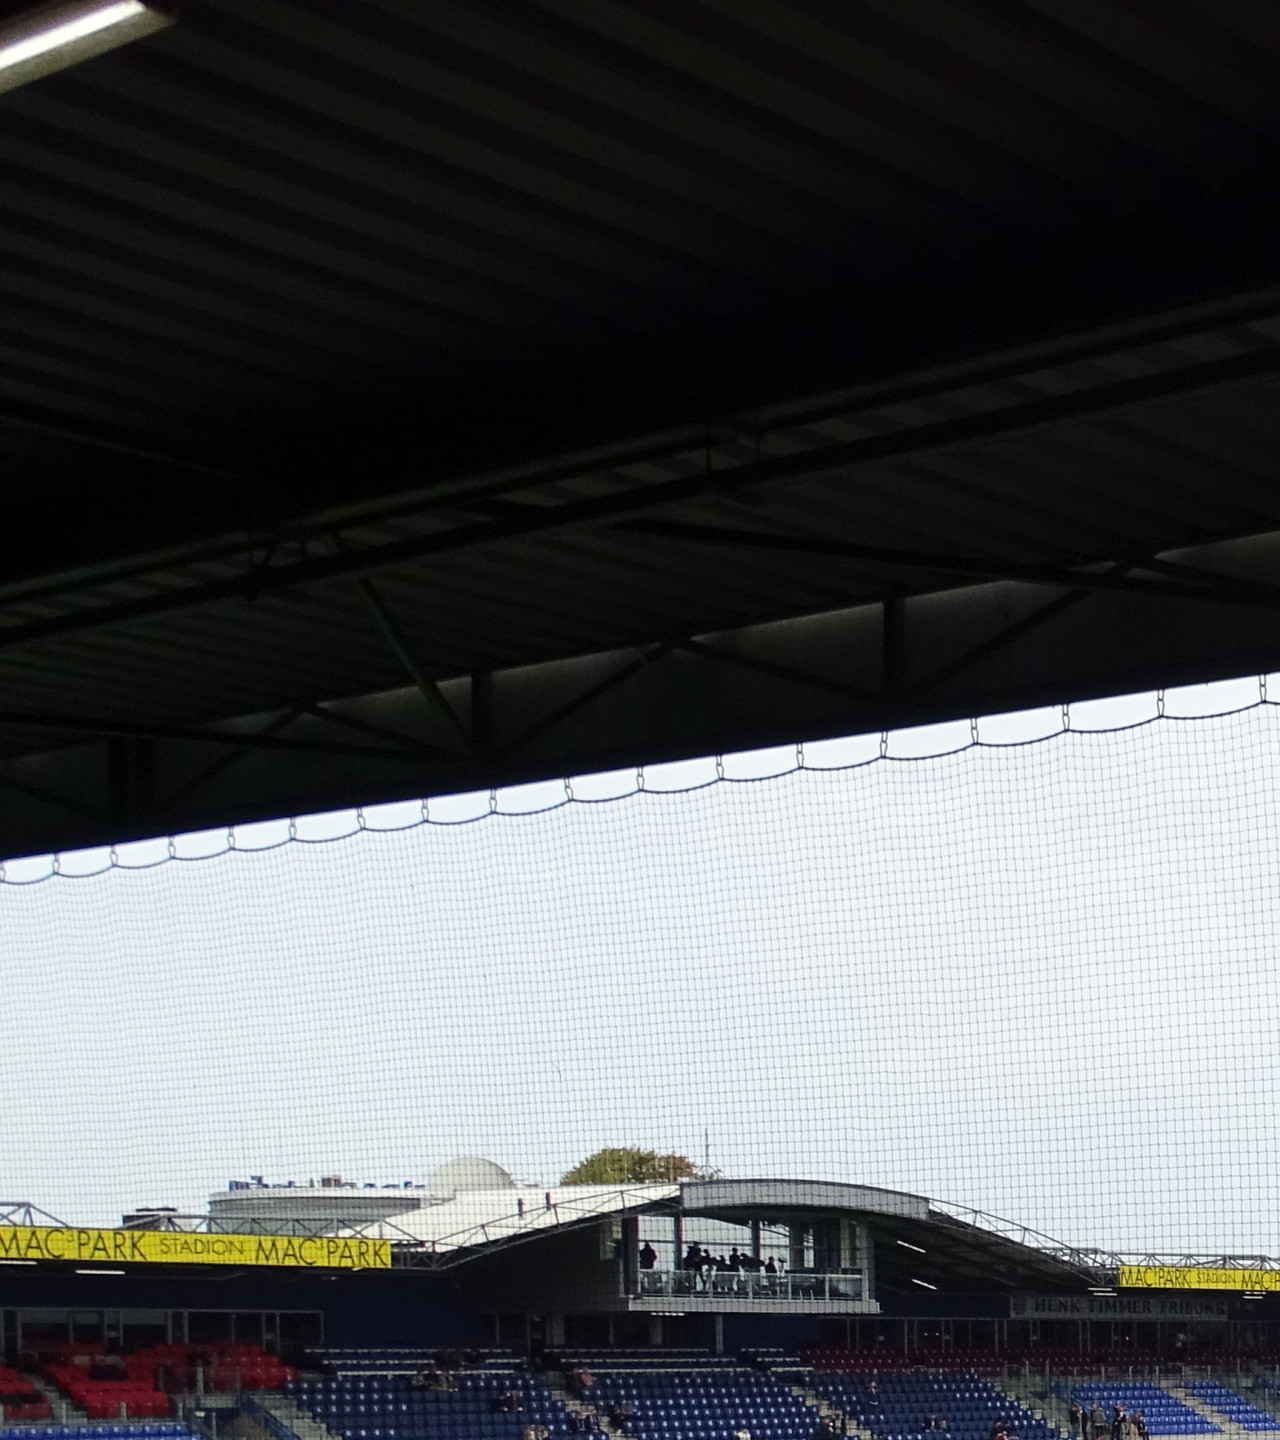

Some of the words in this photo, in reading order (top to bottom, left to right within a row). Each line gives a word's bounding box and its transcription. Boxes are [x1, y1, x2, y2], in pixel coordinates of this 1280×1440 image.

[159, 1236, 244, 1256] STADION
[1197, 1271, 1237, 1284] STADION
[1034, 1301, 1080, 1313] HENK
[1088, 1301, 1151, 1314] TIMMER
[1158, 1302, 1226, 1315] TRIBUNE
